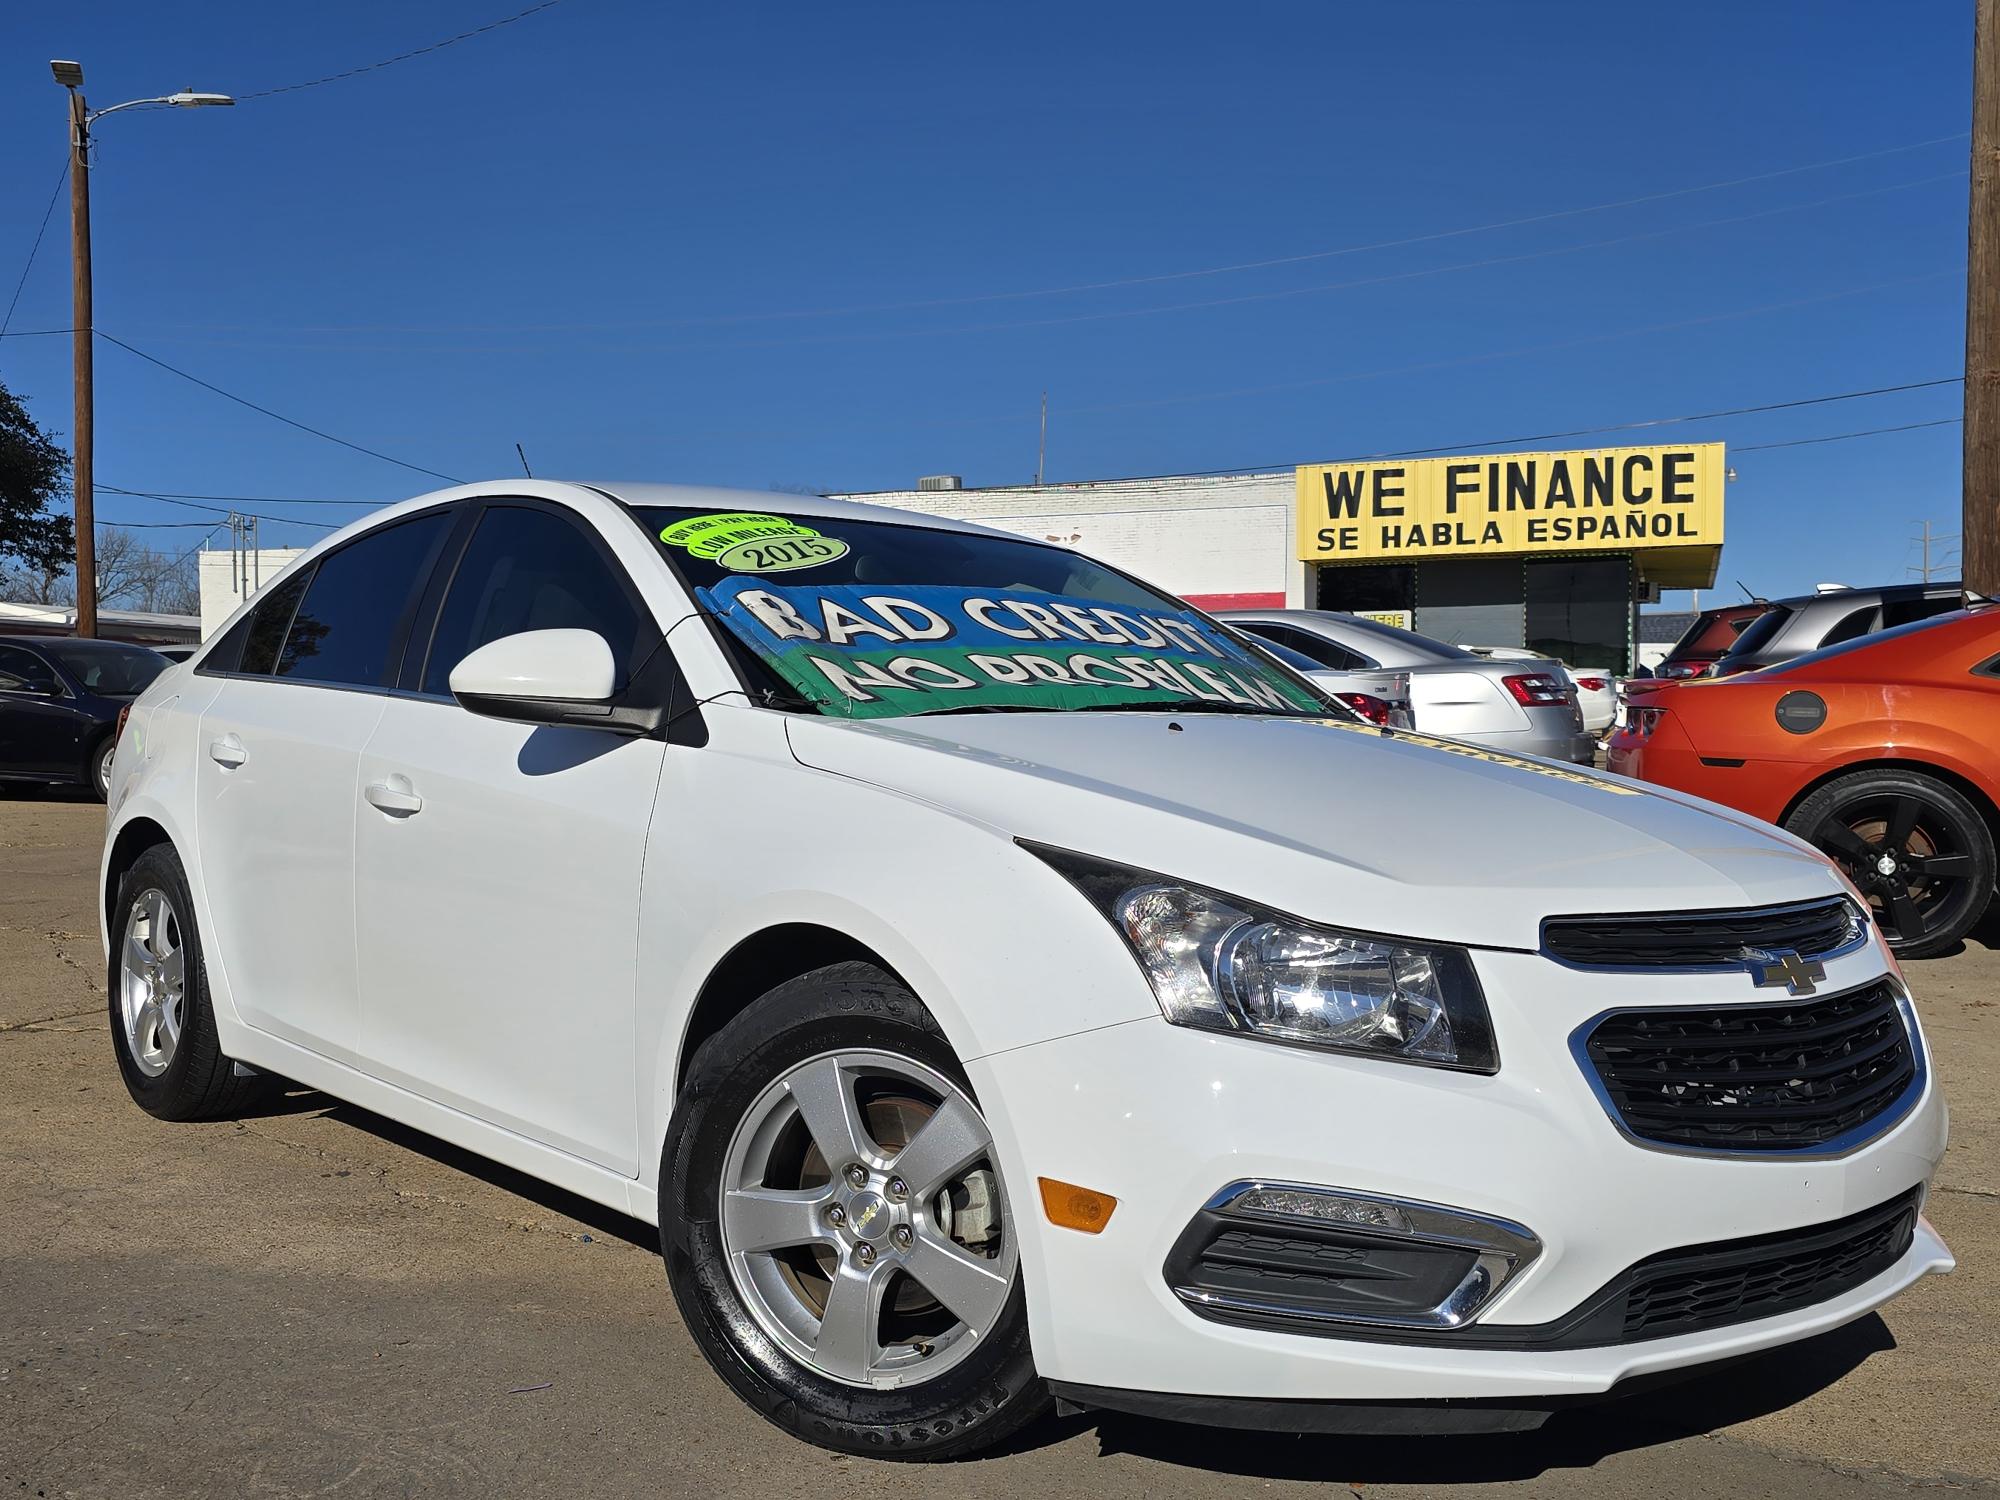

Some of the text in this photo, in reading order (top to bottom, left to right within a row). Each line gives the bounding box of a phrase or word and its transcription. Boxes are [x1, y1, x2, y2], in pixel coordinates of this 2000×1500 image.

[1323, 453, 1695, 519] WE FINANCE
[668, 528, 693, 541] BUY
[694, 526, 802, 554] LOW MILEAGE
[1317, 510, 1699, 551] SE HABLA ESPAÑOL
[742, 538, 832, 569] 2015
[734, 588, 1227, 659] BAD CREDIT
[804, 653, 984, 703] NO
